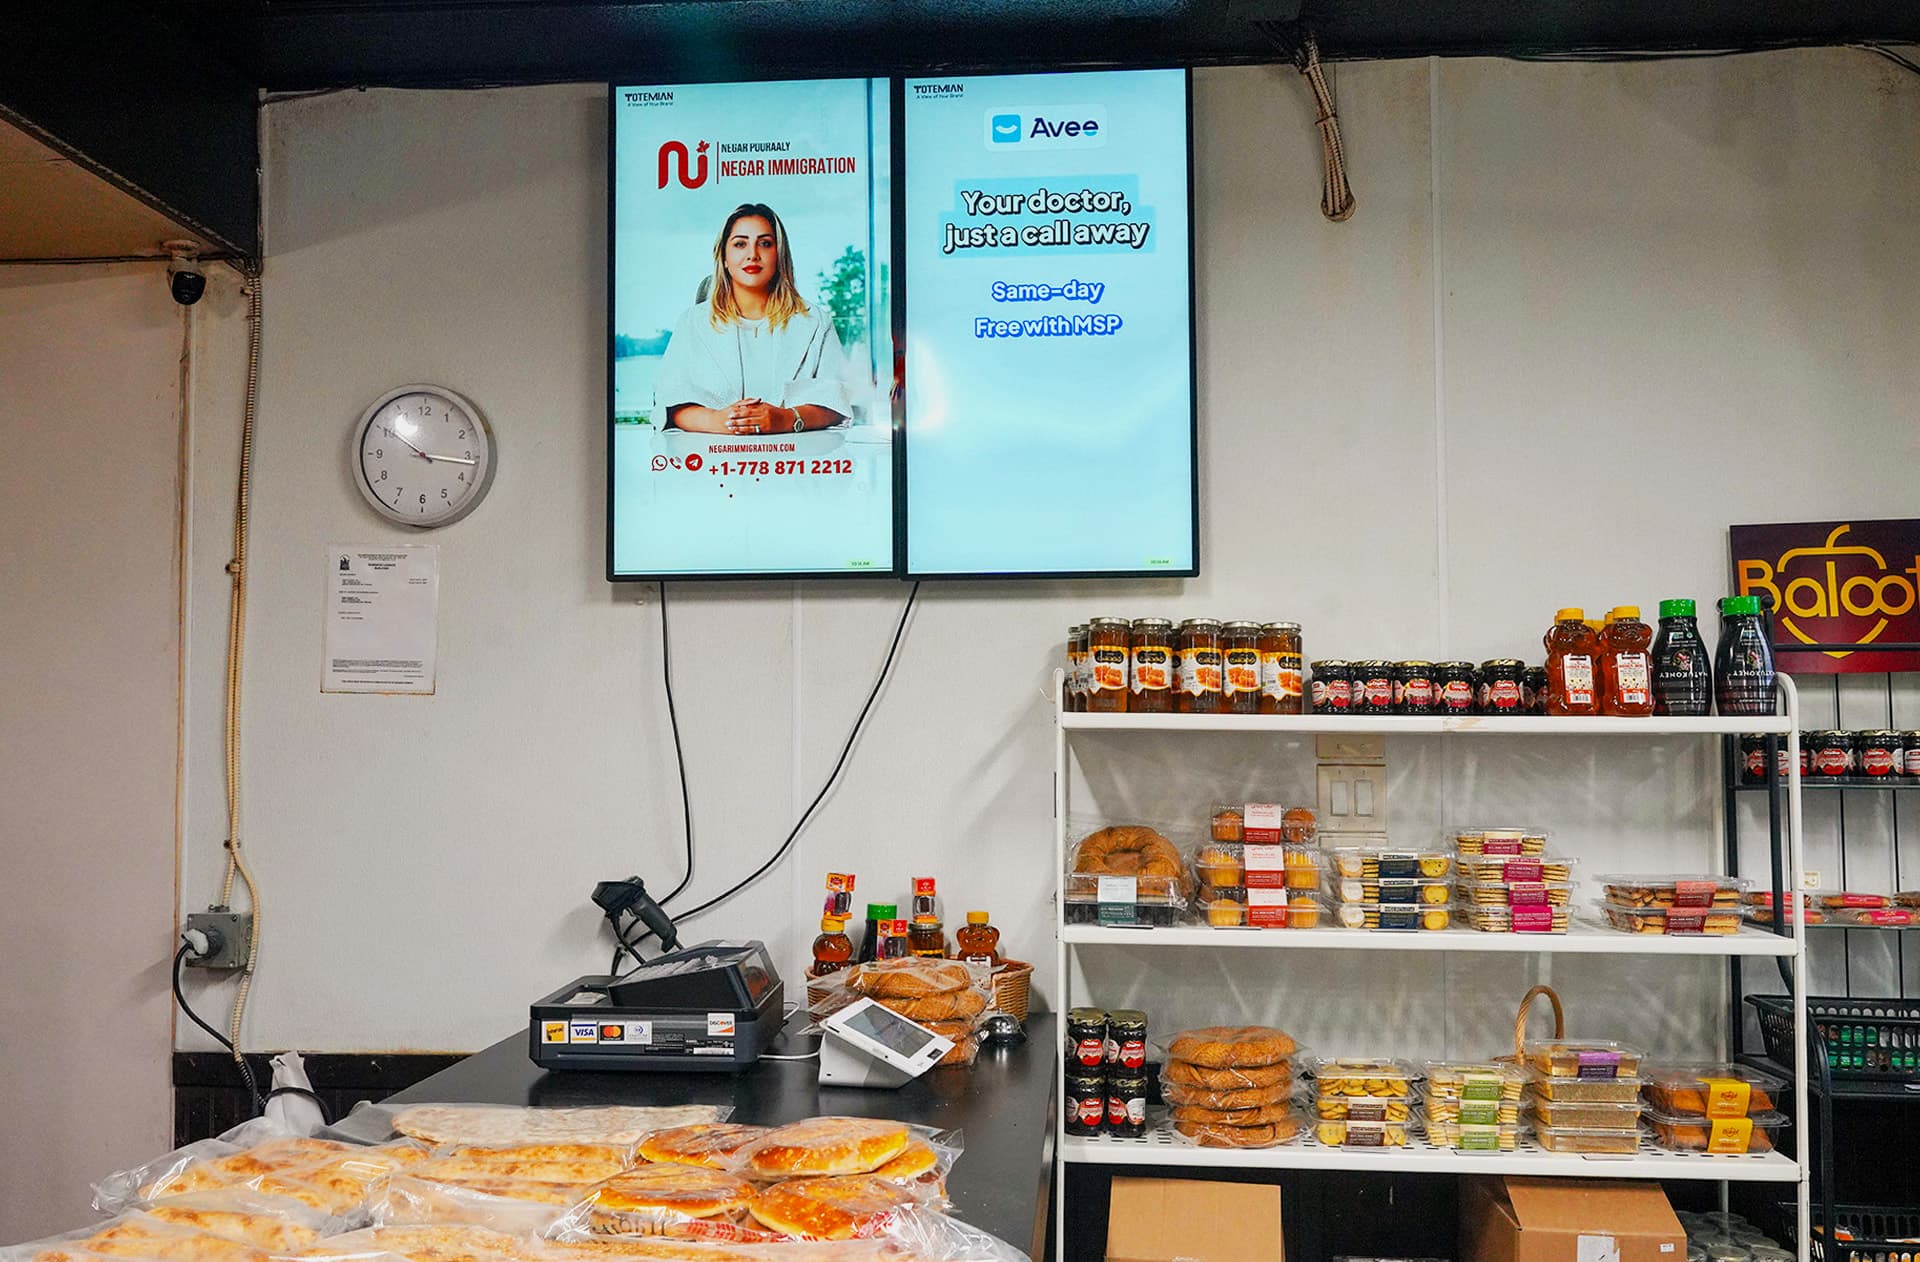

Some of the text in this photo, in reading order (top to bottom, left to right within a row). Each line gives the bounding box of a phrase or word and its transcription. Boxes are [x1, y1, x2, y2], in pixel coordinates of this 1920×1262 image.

[914, 84, 963, 93] TOTEMIAN
[624, 92, 673, 101] TOTEMIAN
[1030, 117, 1099, 138] Avee
[721, 143, 748, 153] NEGAR
[721, 157, 856, 177] NEGAR IMMIGRATION
[961, 188, 1132, 216] Your doctor,
[943, 219, 1150, 254] just a call away
[992, 279, 1105, 304] Same-day
[975, 314, 1122, 338] Free with MSP
[418, 406, 432, 416] 12
[444, 413, 449, 422] 1
[458, 429, 466, 439] 2
[709, 443, 795, 454] NEGARIMMIGRATION.COM
[375, 449, 383, 459] 9
[464, 450, 471, 460] 3
[709, 459, 852, 475] +1-778 871 2212
[380, 470, 388, 480] 8
[457, 472, 465, 481] 4
[396, 487, 403, 497] 7
[440, 489, 448, 499] 5
[419, 494, 426, 504] 6
[575, 1028, 594, 1036] VISA
